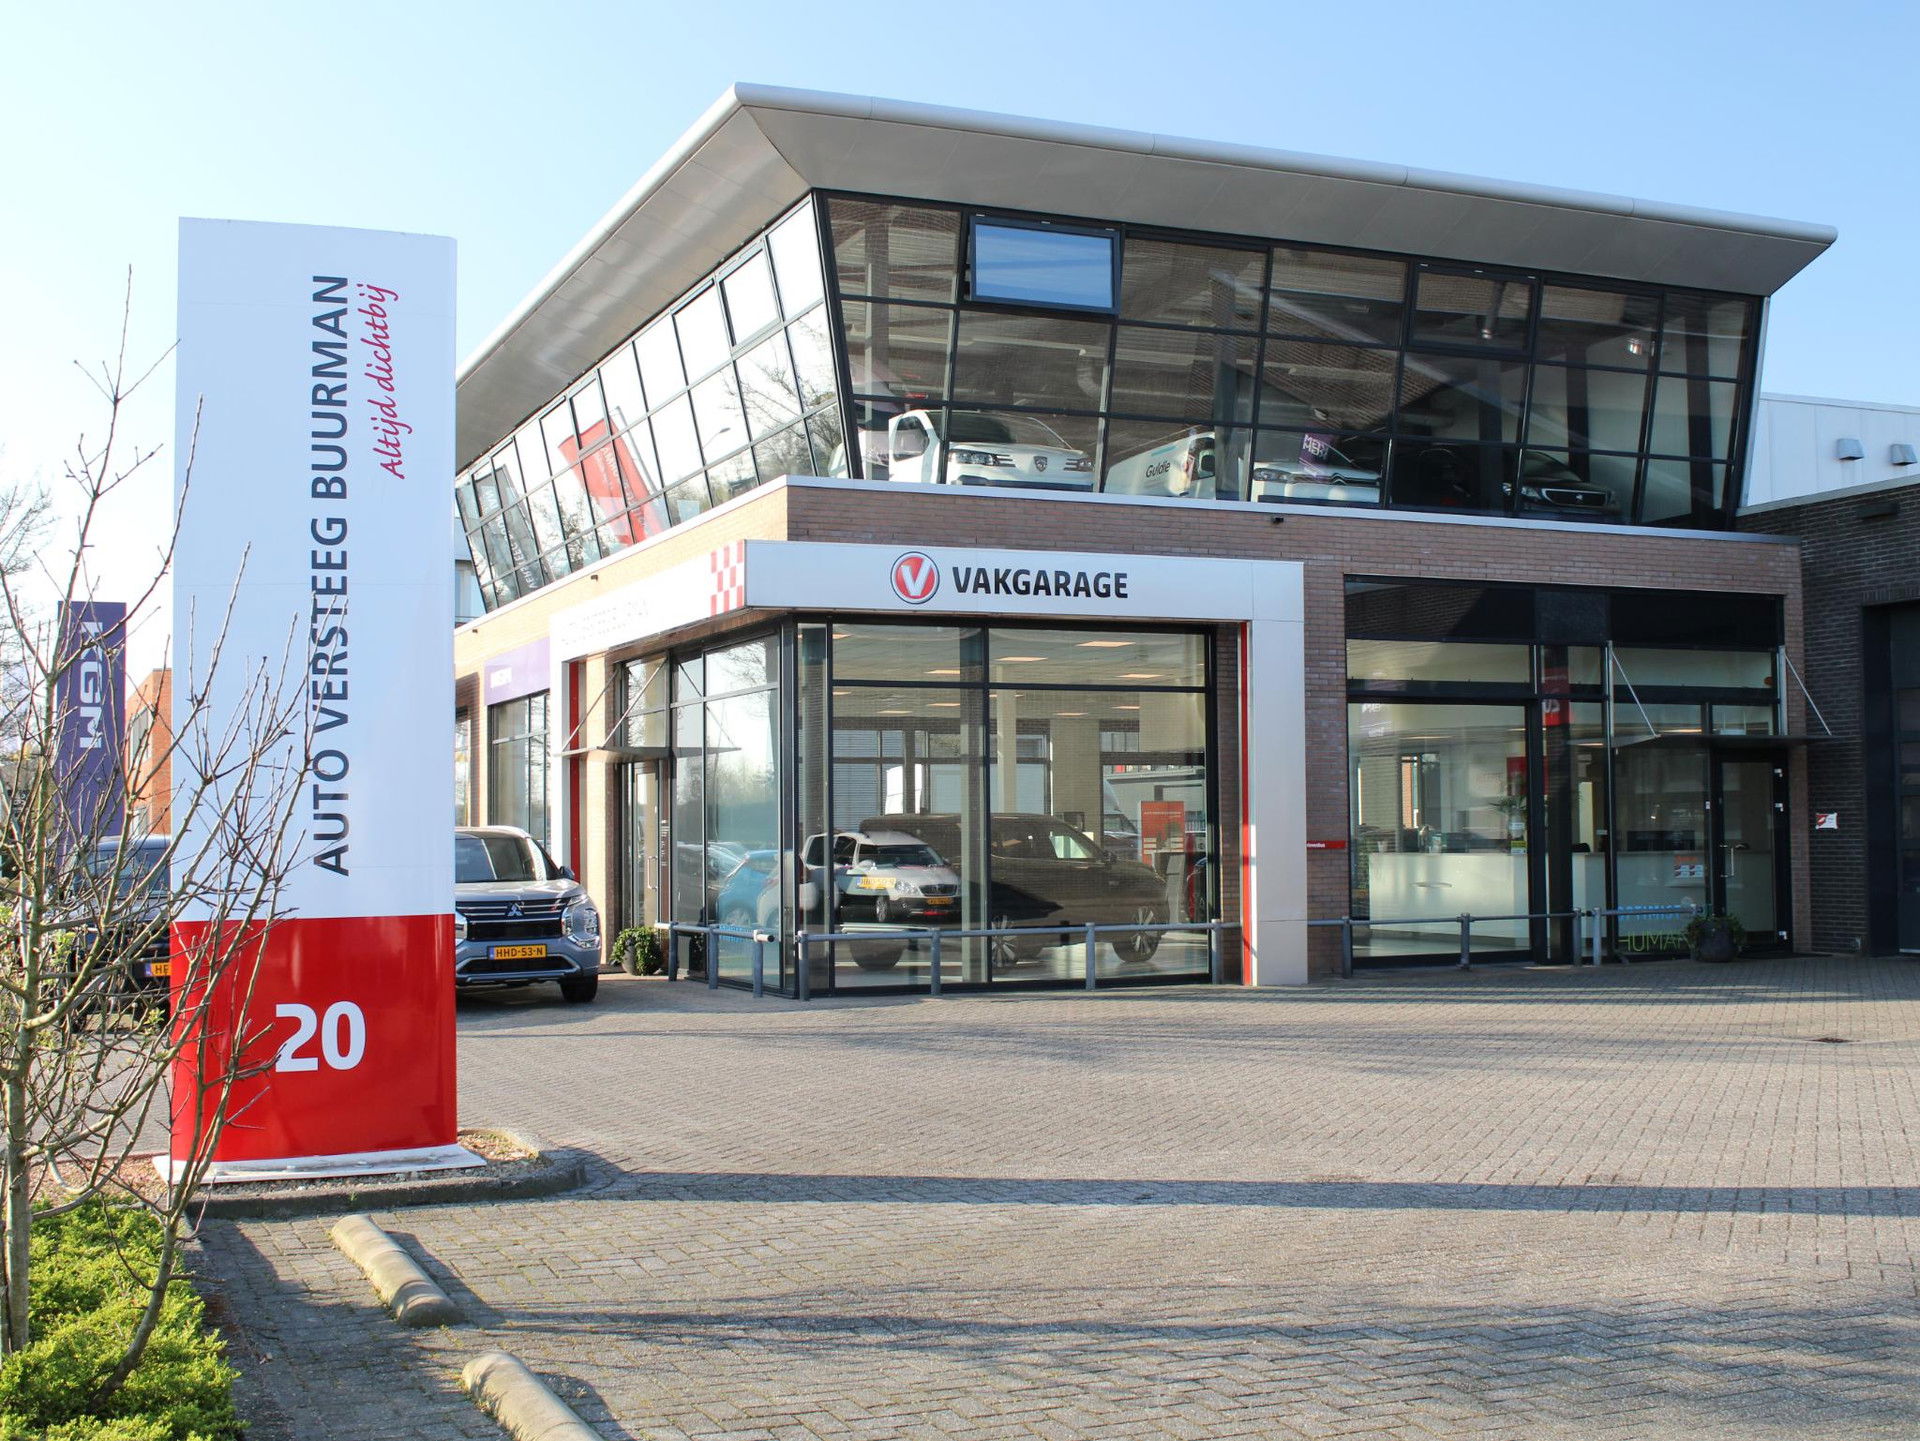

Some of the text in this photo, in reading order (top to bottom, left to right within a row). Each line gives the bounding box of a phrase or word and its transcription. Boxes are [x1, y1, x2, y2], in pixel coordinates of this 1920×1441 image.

[356, 282, 413, 480] Altijd dichtbij
[310, 274, 350, 877] AUTO VERSTEEG BUURMAN
[952, 566, 1128, 599] VAKGARAGE
[79, 621, 103, 749] KGM
[496, 947, 543, 958] HHD-53-N
[275, 1001, 367, 1074] 20
